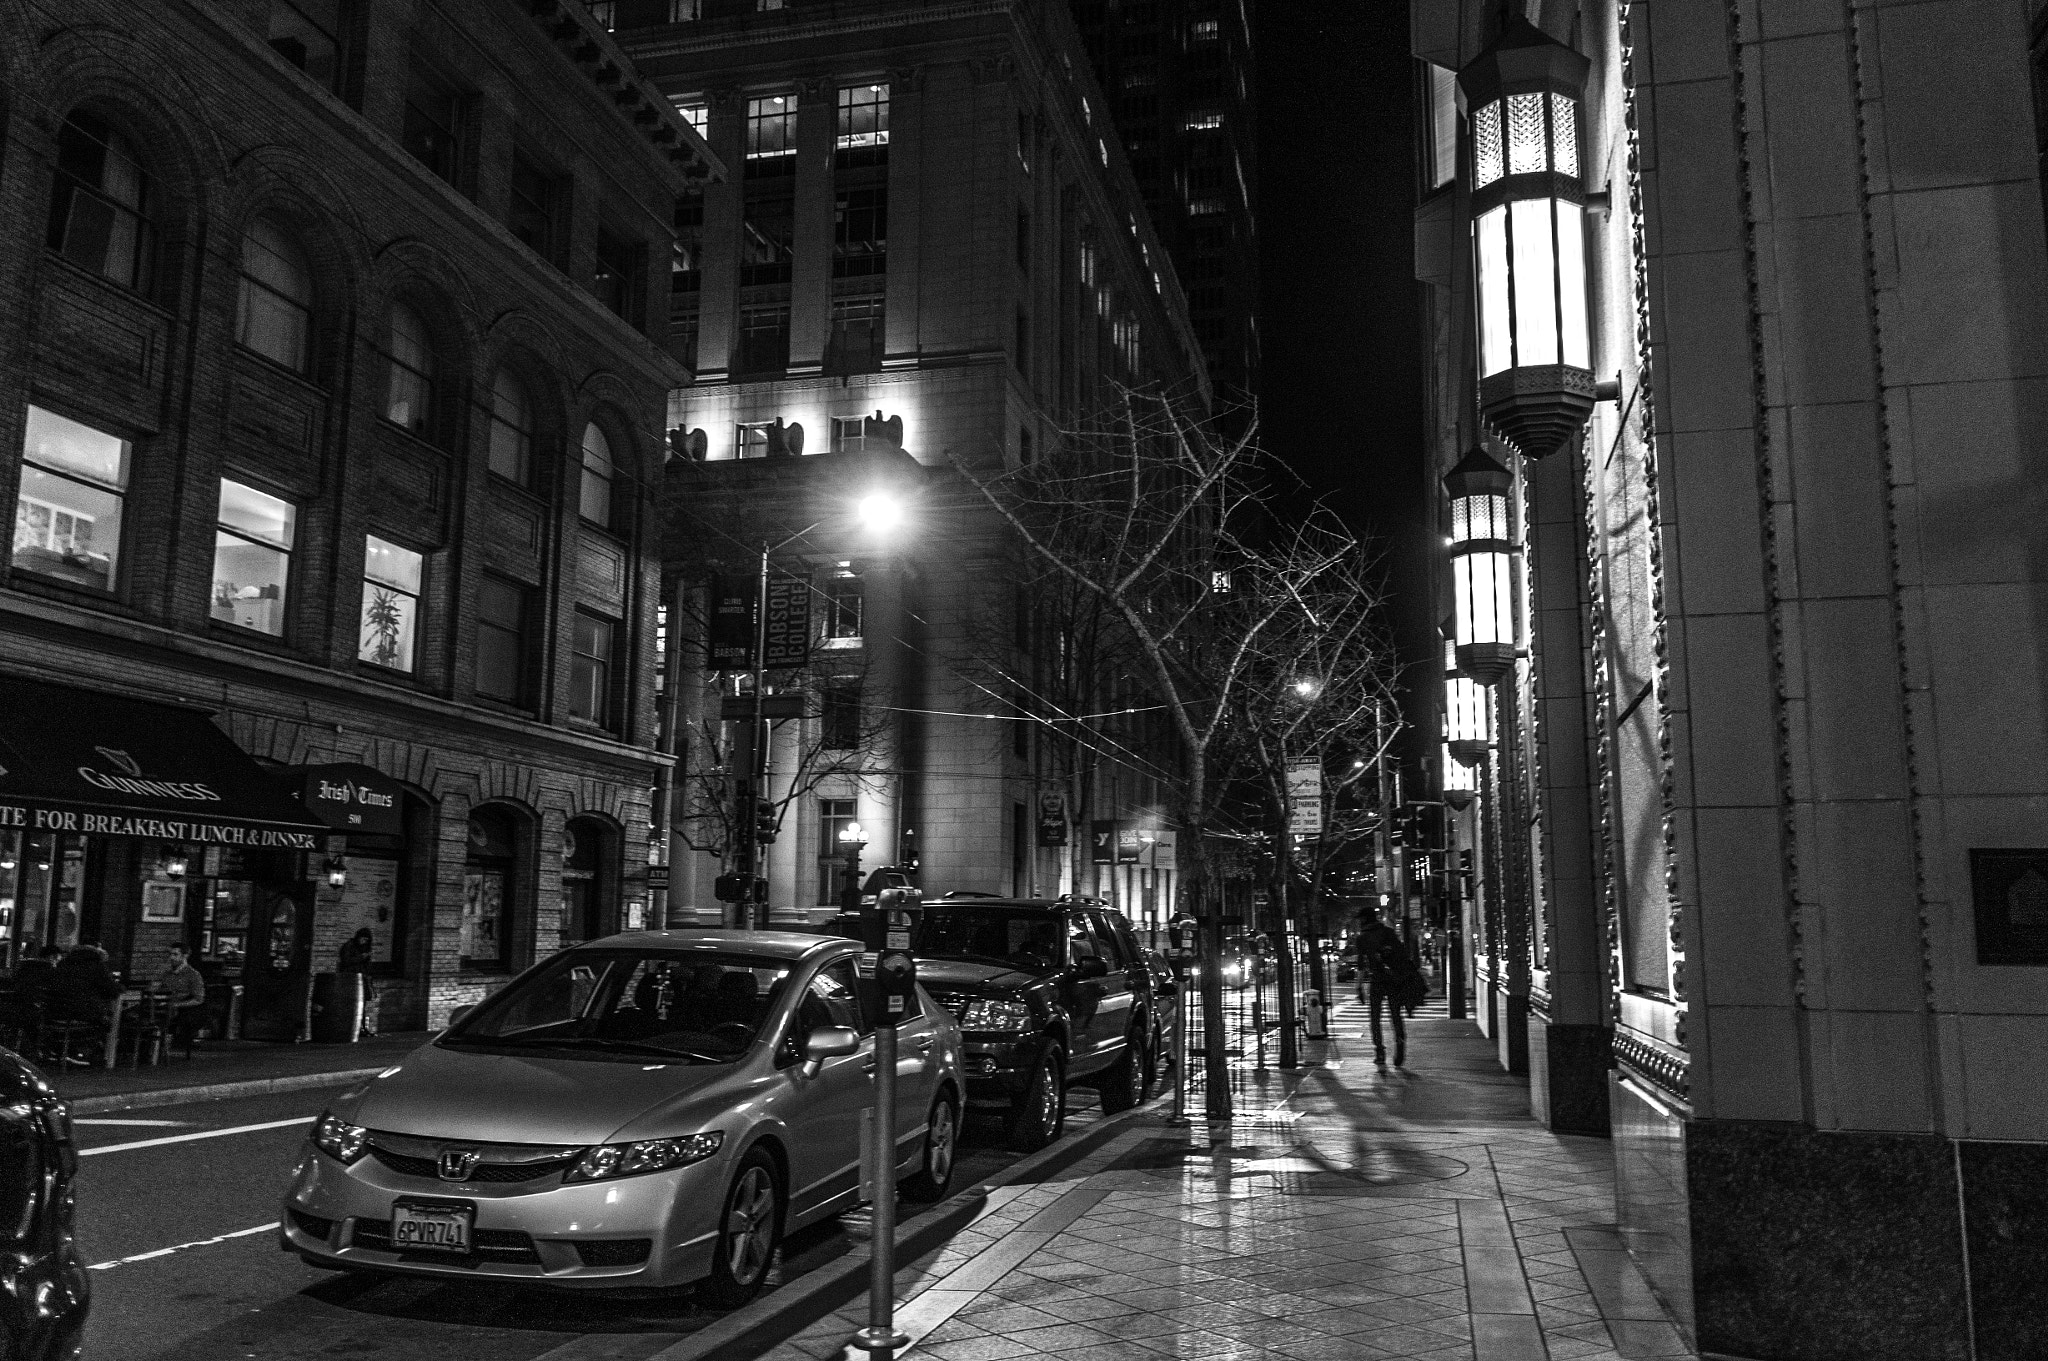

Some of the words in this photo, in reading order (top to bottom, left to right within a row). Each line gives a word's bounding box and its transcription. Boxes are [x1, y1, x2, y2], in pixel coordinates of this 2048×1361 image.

[768, 584, 790, 658] BABSON
[787, 584, 809, 656] COLLEGE
[77, 766, 221, 801] GUINNESS
[318, 780, 350, 804] Irish
[358, 785, 393, 807] Times
[34, 809, 78, 831] FOR
[82, 812, 188, 840] BREAKFAST
[190, 823, 246, 845] LUNCH
[247, 829, 260, 846] &
[261, 830, 316, 849] DINNER
[397, 1220, 465, 1245] 6PVR741
